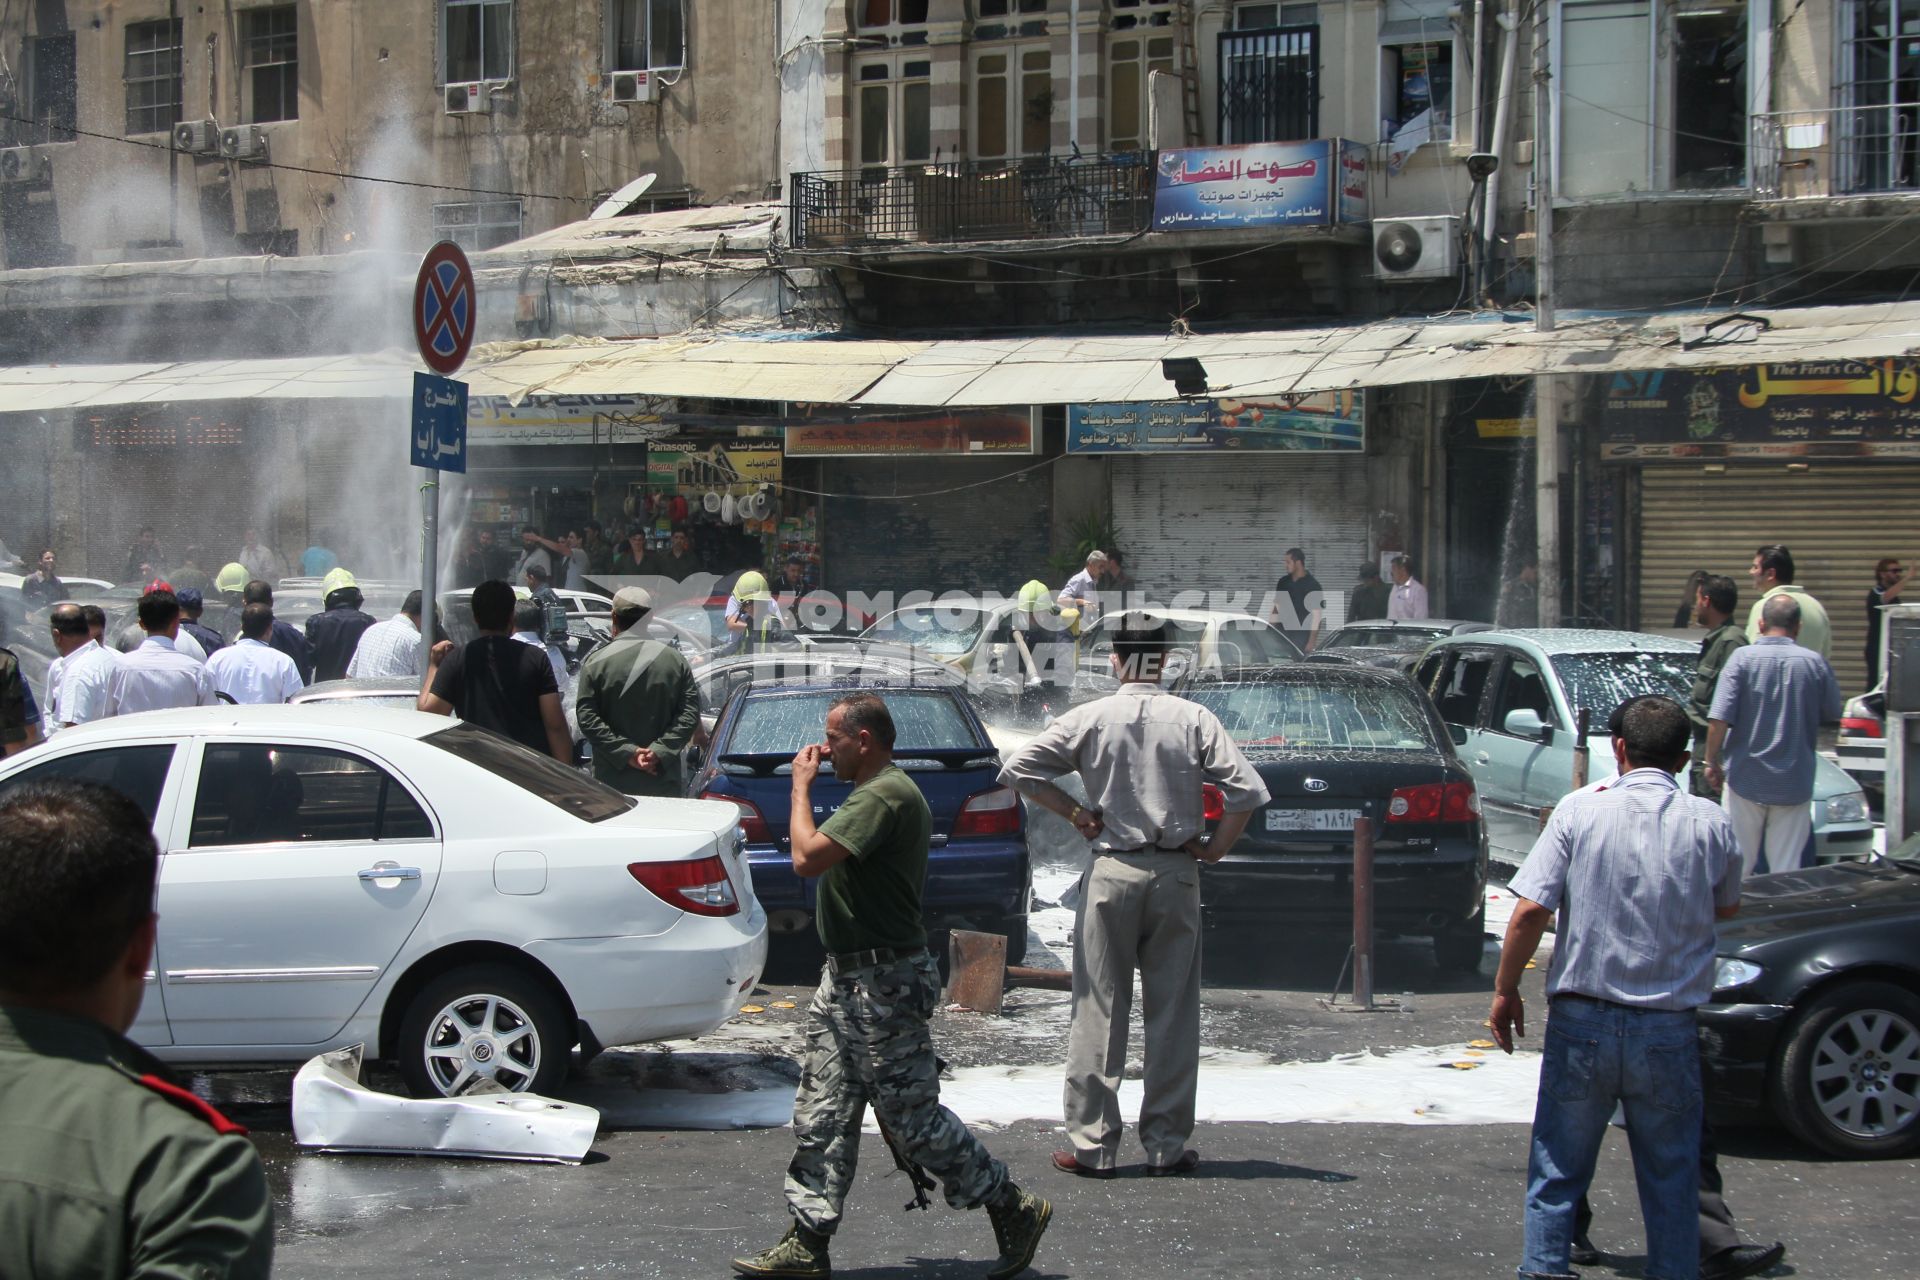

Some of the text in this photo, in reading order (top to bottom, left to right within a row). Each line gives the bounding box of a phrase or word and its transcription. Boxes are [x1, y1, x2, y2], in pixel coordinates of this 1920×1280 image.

[1246, 158, 1316, 184] صوت
[1199, 187, 1284, 205] تجهيزات صوتية
[1160, 211, 1193, 225] مدارس
[1200, 210, 1236, 223] مساجد
[1285, 206, 1322, 218] مطاعم
[1772, 364, 1795, 375] The
[1799, 364, 1841, 375] First's
[1843, 363, 1867, 374] Co.
[424, 384, 457, 408] مخرج
[647, 441, 697, 452] Panasonic
[648, 462, 674, 473] DIGITAL
[1306, 781, 1327, 791] KIA
